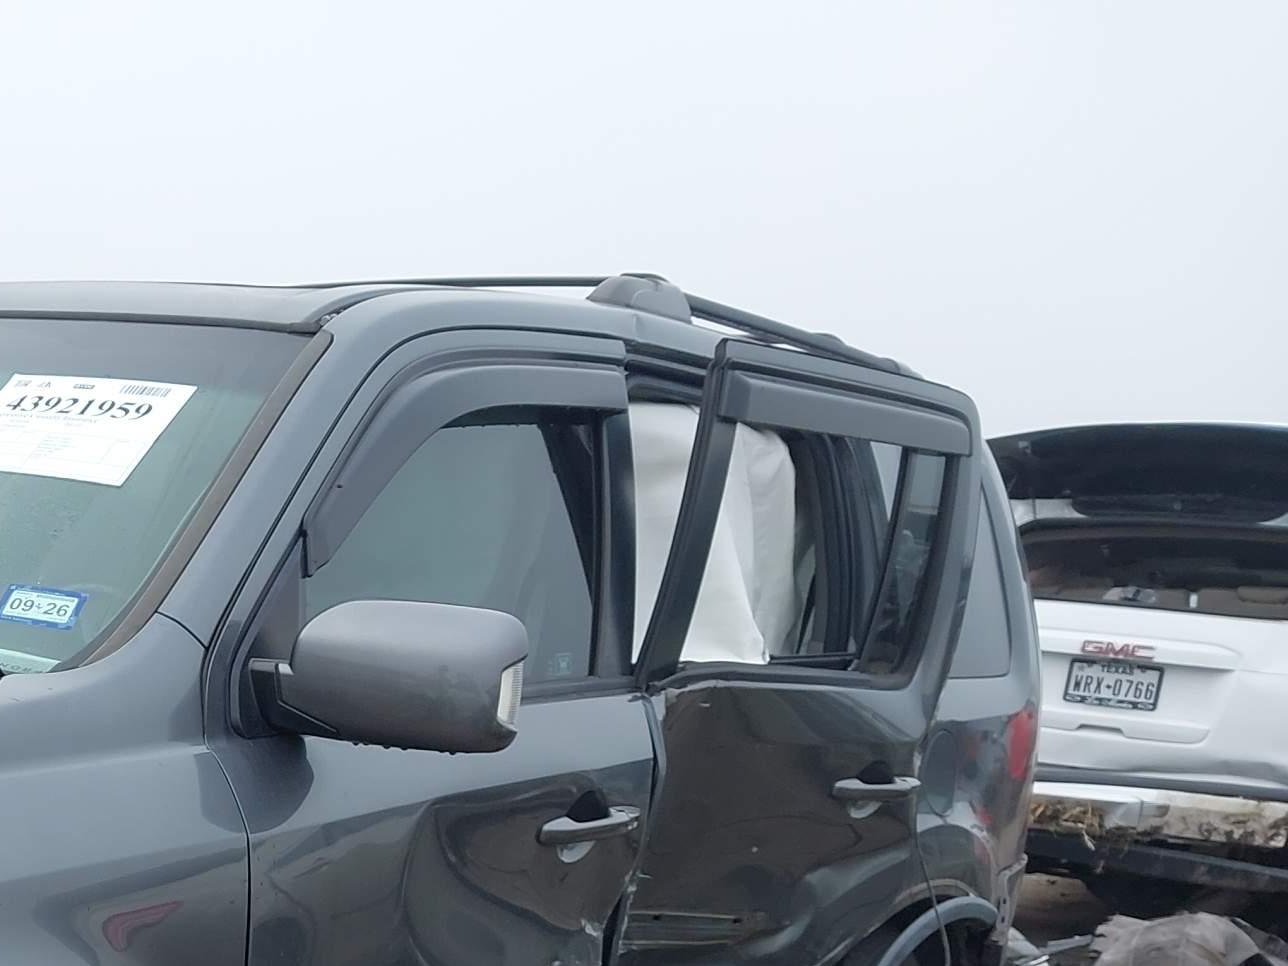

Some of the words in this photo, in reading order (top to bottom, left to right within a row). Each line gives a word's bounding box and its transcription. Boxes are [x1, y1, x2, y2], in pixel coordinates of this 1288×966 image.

[5, 394, 154, 421] 43921959
[1081, 640, 1156, 661] GMC
[1100, 664, 1134, 676] TEXAS
